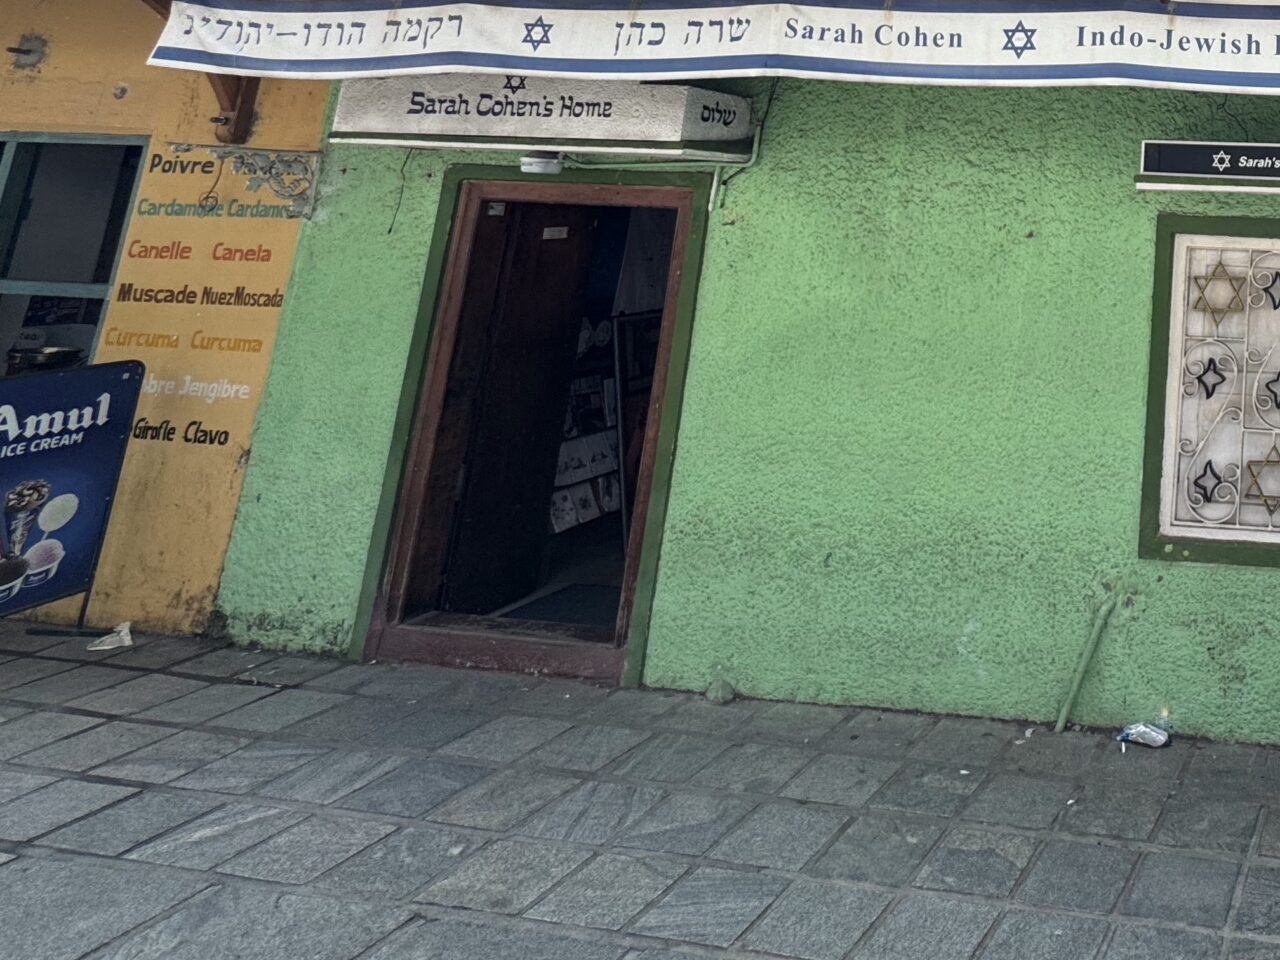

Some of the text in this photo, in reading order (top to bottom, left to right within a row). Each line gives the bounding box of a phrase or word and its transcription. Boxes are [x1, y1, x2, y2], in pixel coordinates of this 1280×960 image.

[381, 14, 464, 49] רקמה
[613, 17, 751, 56] שרה כהן
[784, 17, 963, 48] Sarah Cohen
[1076, 24, 1261, 56] Indo-Jewish
[407, 91, 613, 119] Sarah Cohen's Home
[700, 103, 737, 126] שלום
[149, 153, 215, 174] Poivre
[1237, 155, 1280, 168] Sarah's
[128, 240, 272, 262] Canelle Canela
[117, 283, 198, 304] Muscade
[104, 327, 263, 352] Curcuma Curcuma
[178, 375, 250, 404] Jengibre
[0, 392, 111, 442] Amul
[133, 417, 230, 445] Girofle Clavo
[0, 431, 84, 458] ICE CREAM
